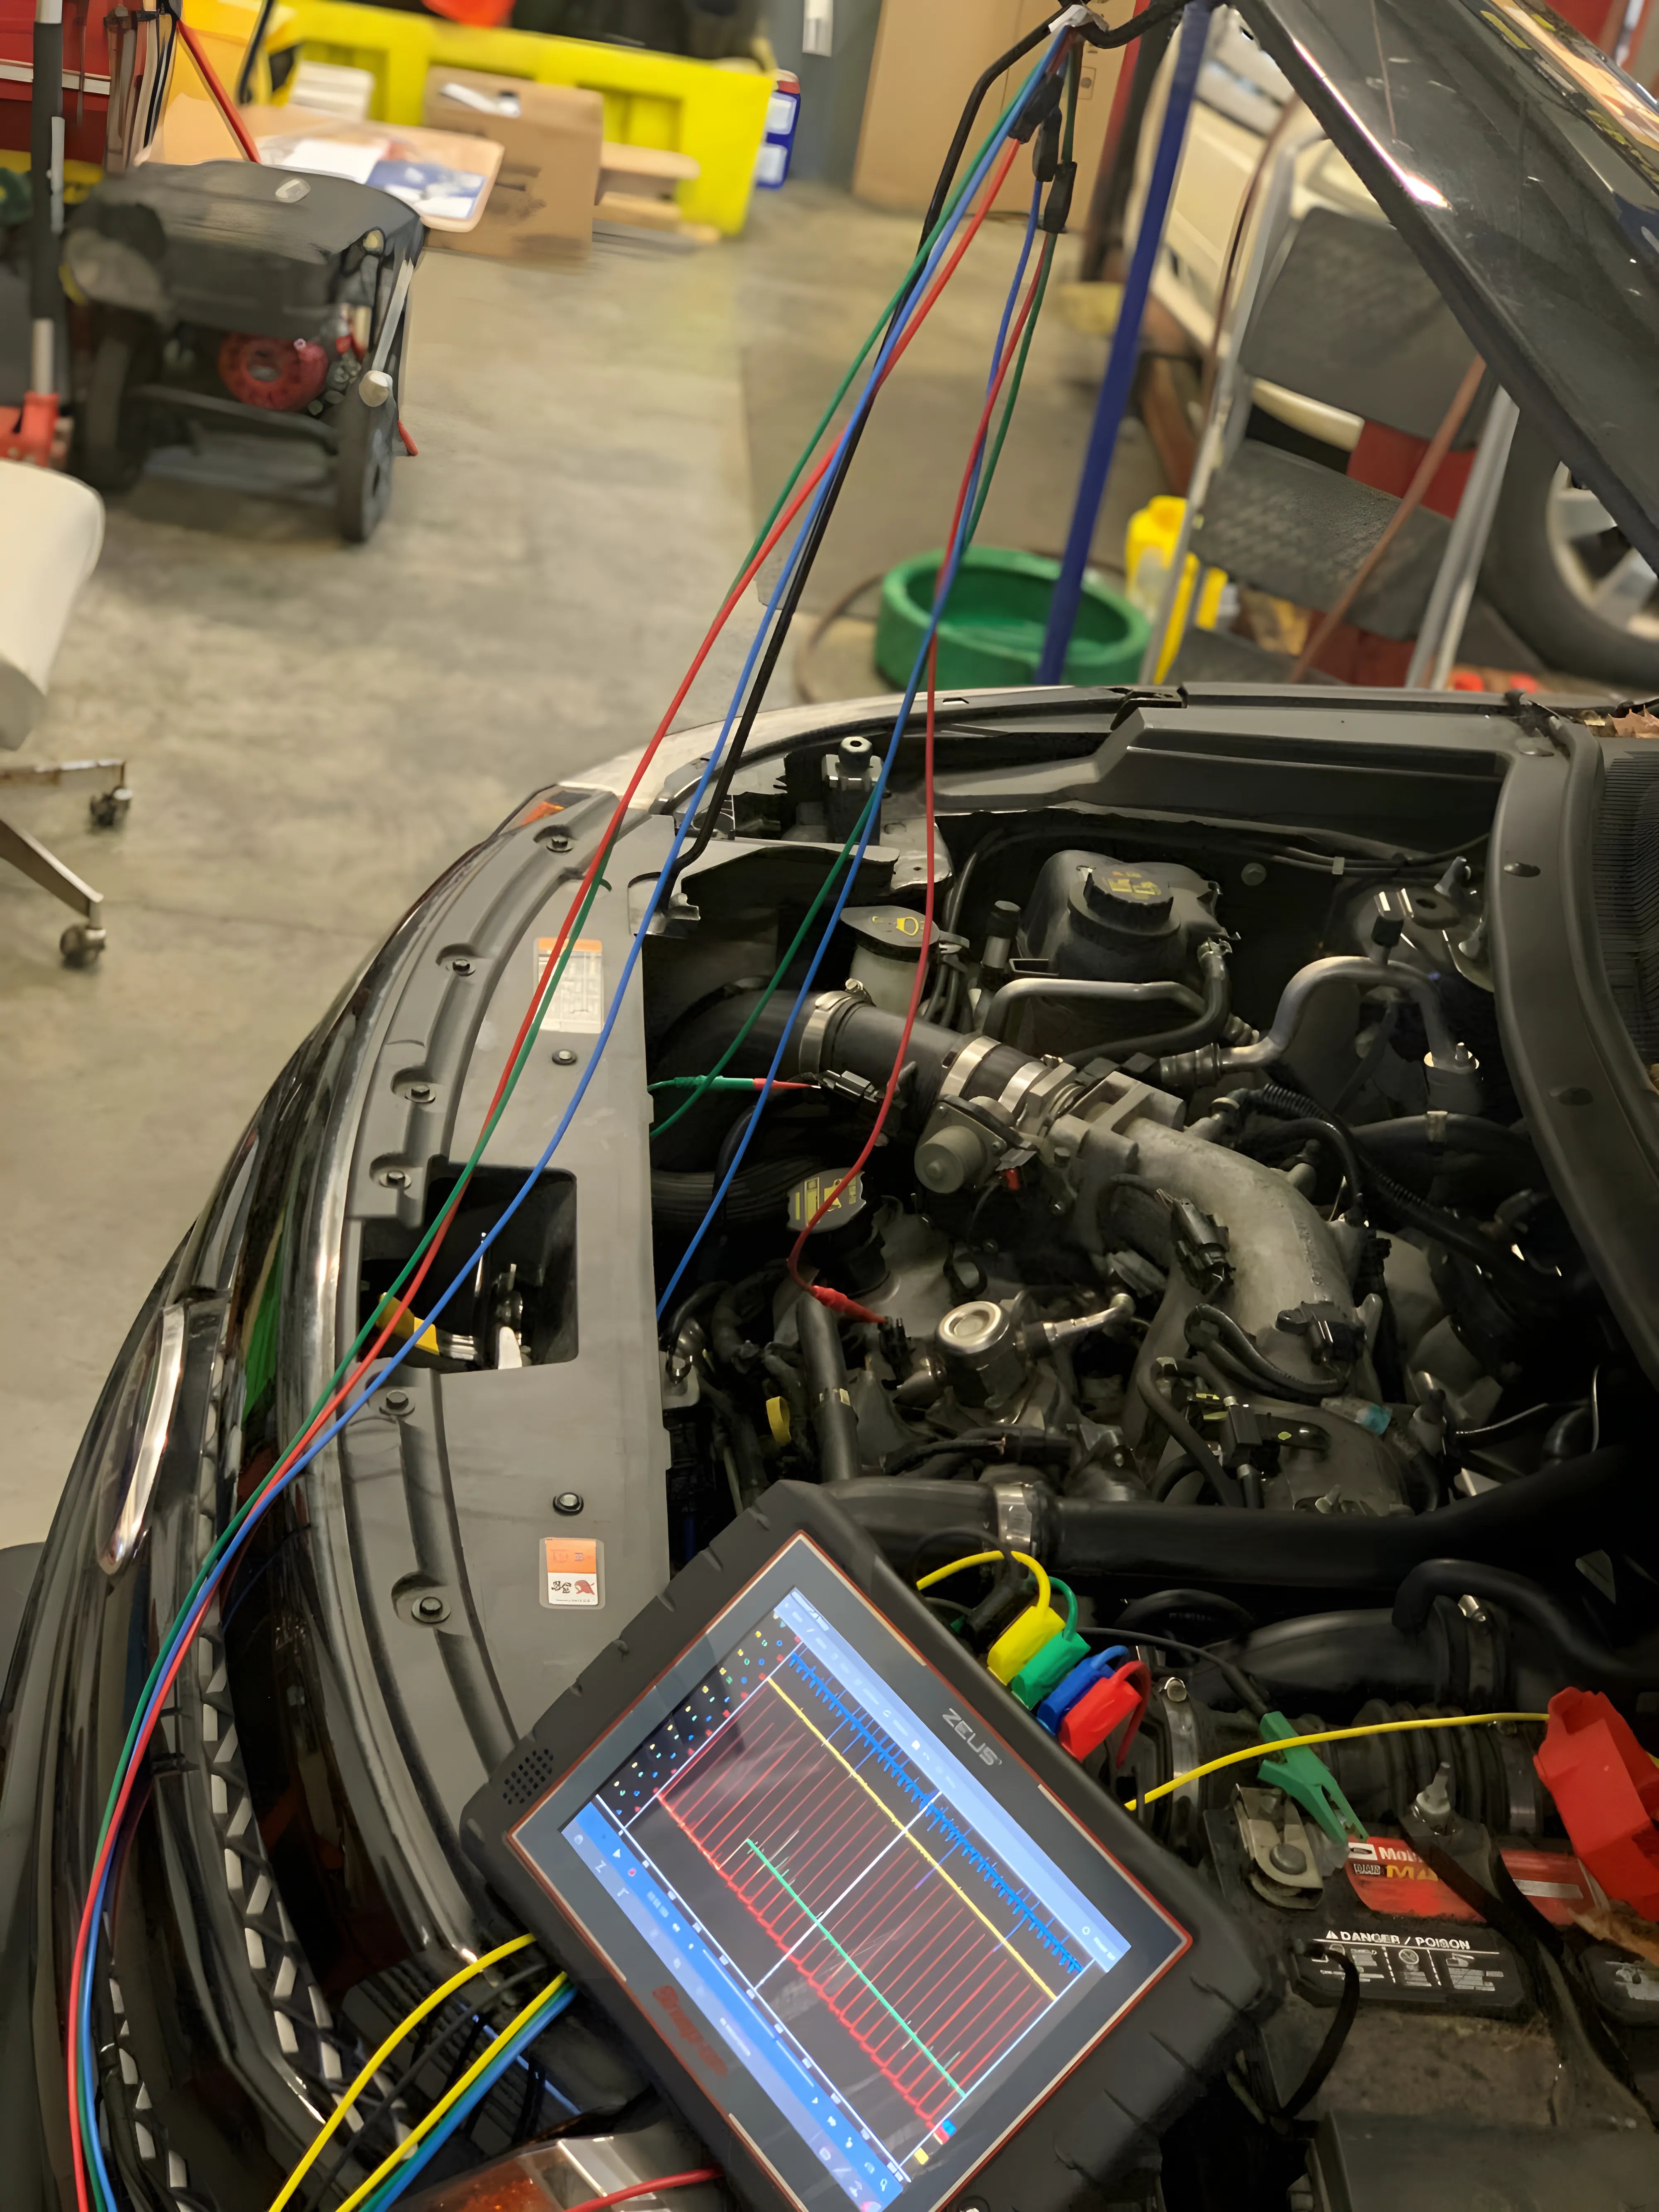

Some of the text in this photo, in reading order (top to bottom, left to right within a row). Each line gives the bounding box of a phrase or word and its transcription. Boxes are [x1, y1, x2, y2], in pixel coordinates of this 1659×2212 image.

[942, 1708, 999, 1766] ZEUS
[1385, 1865, 1438, 1881] MA
[1340, 1931, 1401, 1945] DANGER
[1415, 1936, 1470, 1950] POISON
